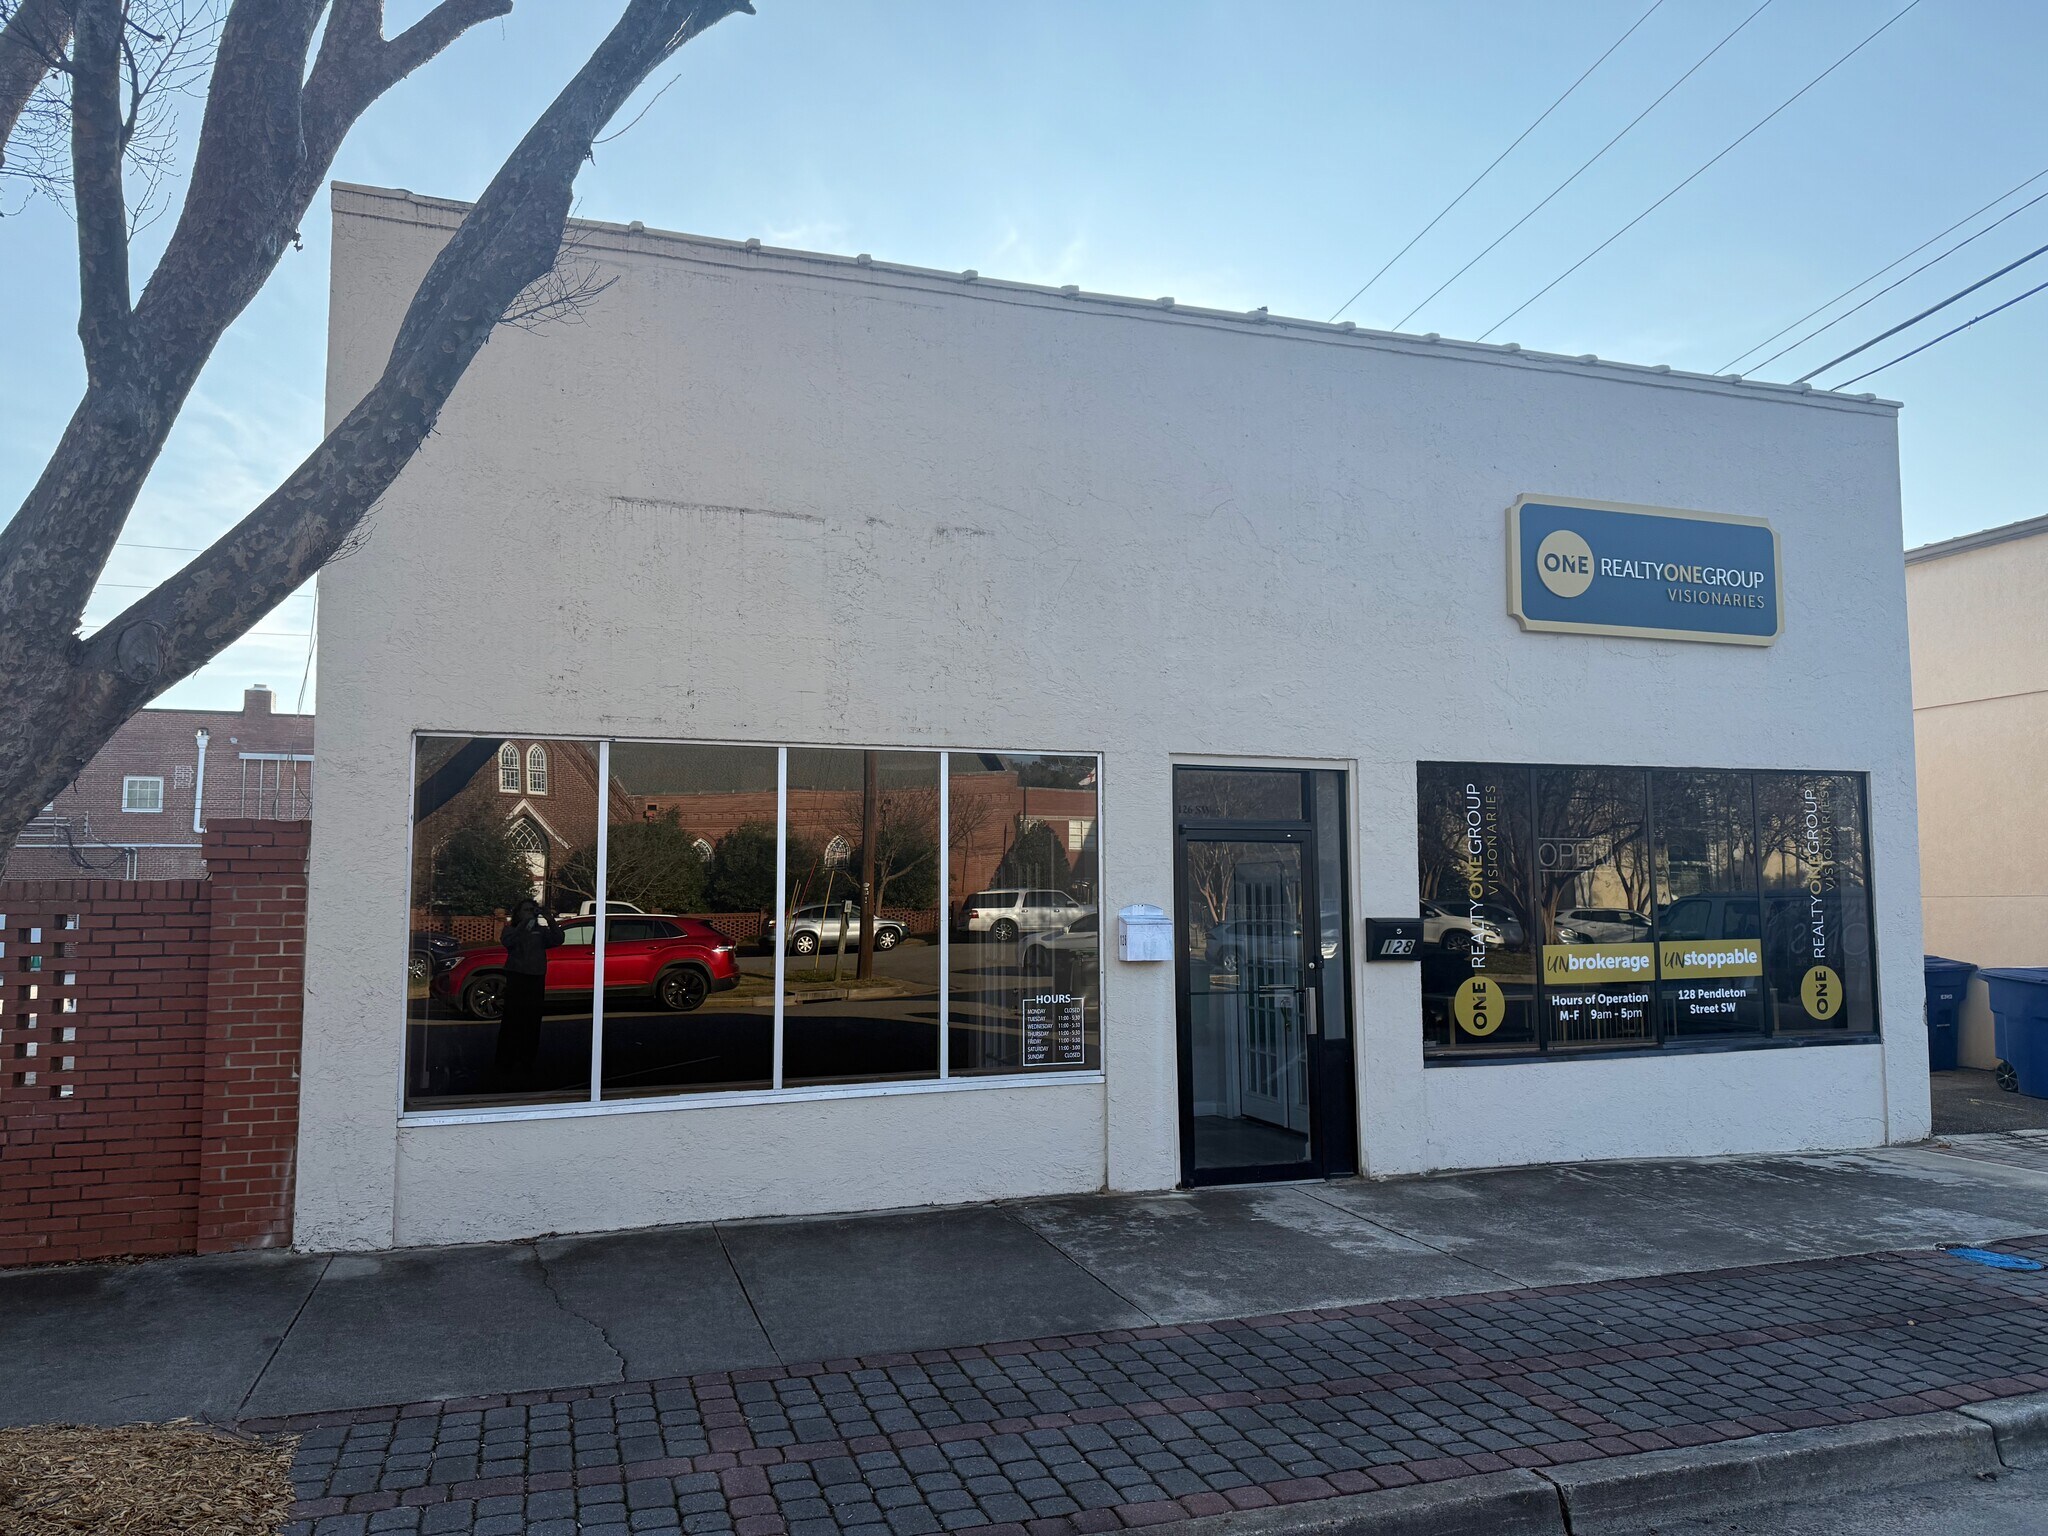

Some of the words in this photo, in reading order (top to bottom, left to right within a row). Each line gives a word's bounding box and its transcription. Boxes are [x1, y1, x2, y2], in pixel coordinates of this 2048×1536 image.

[1543, 552, 1589, 575] ONE
[1600, 557, 1765, 589] REALTYONEGROUP
[1667, 588, 1765, 609] VISIONARIES
[1485, 785, 1499, 895] VISIONARIES
[1820, 790, 1835, 892] VISIONARIES
[1539, 842, 1610, 867] OPEN
[1466, 783, 1486, 968] REALTYONEGROUP
[1804, 789, 1826, 958] REALTYONEGROUP
[1385, 940, 1414, 954] 128
[1547, 953, 1650, 973] UNbrokerage
[1664, 948, 1758, 969] UNstoppable
[1036, 994, 1071, 1004] HOURS
[1552, 995, 1583, 1006] Hours
[1585, 994, 1596, 1004] of
[1598, 993, 1649, 1006] Operation
[1678, 989, 1696, 1000] 128
[1698, 988, 1746, 999] Pendleton
[1815, 970, 1829, 1014] ONE
[1472, 982, 1488, 1030] ONE
[1560, 1010, 1580, 1021] M-F
[1591, 1009, 1612, 1019] 9am
[1621, 1008, 1642, 1020] 5pm
[1690, 1003, 1719, 1014] Street
[1720, 1002, 1736, 1013] SW
